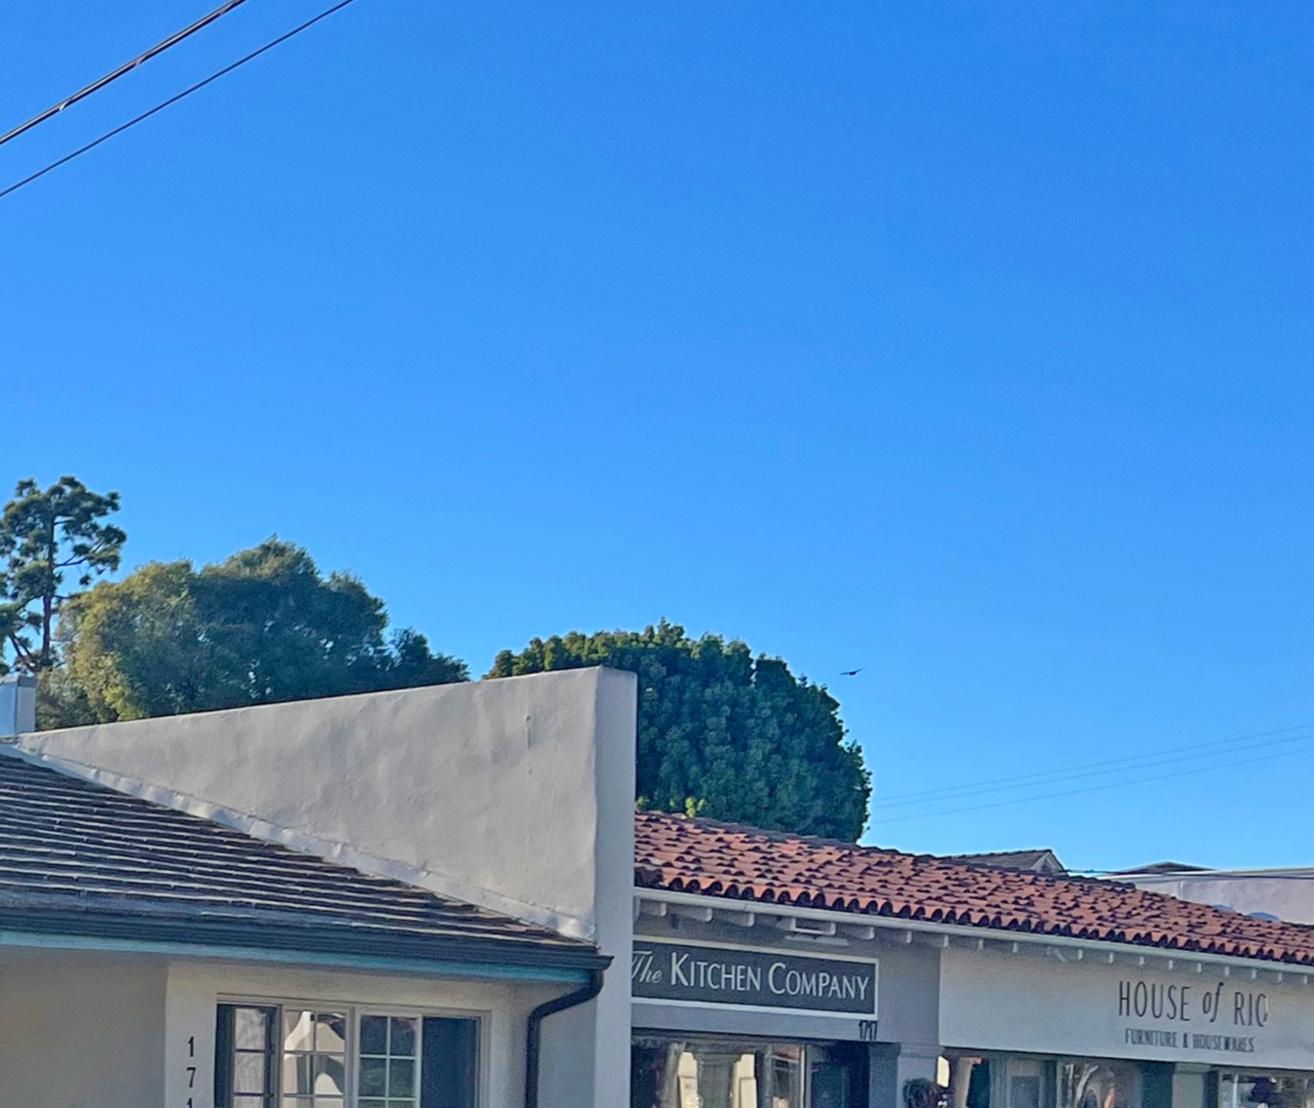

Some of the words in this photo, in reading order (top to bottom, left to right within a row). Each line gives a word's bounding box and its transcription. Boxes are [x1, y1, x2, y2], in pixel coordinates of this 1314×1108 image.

[631, 950, 663, 984] The
[670, 952, 762, 992] KITCHEN
[768, 962, 870, 1001] COMPANY
[1118, 980, 1192, 1022] HOUSE
[1202, 981, 1225, 1024] of
[1124, 1028, 1179, 1049] FURNITURE
